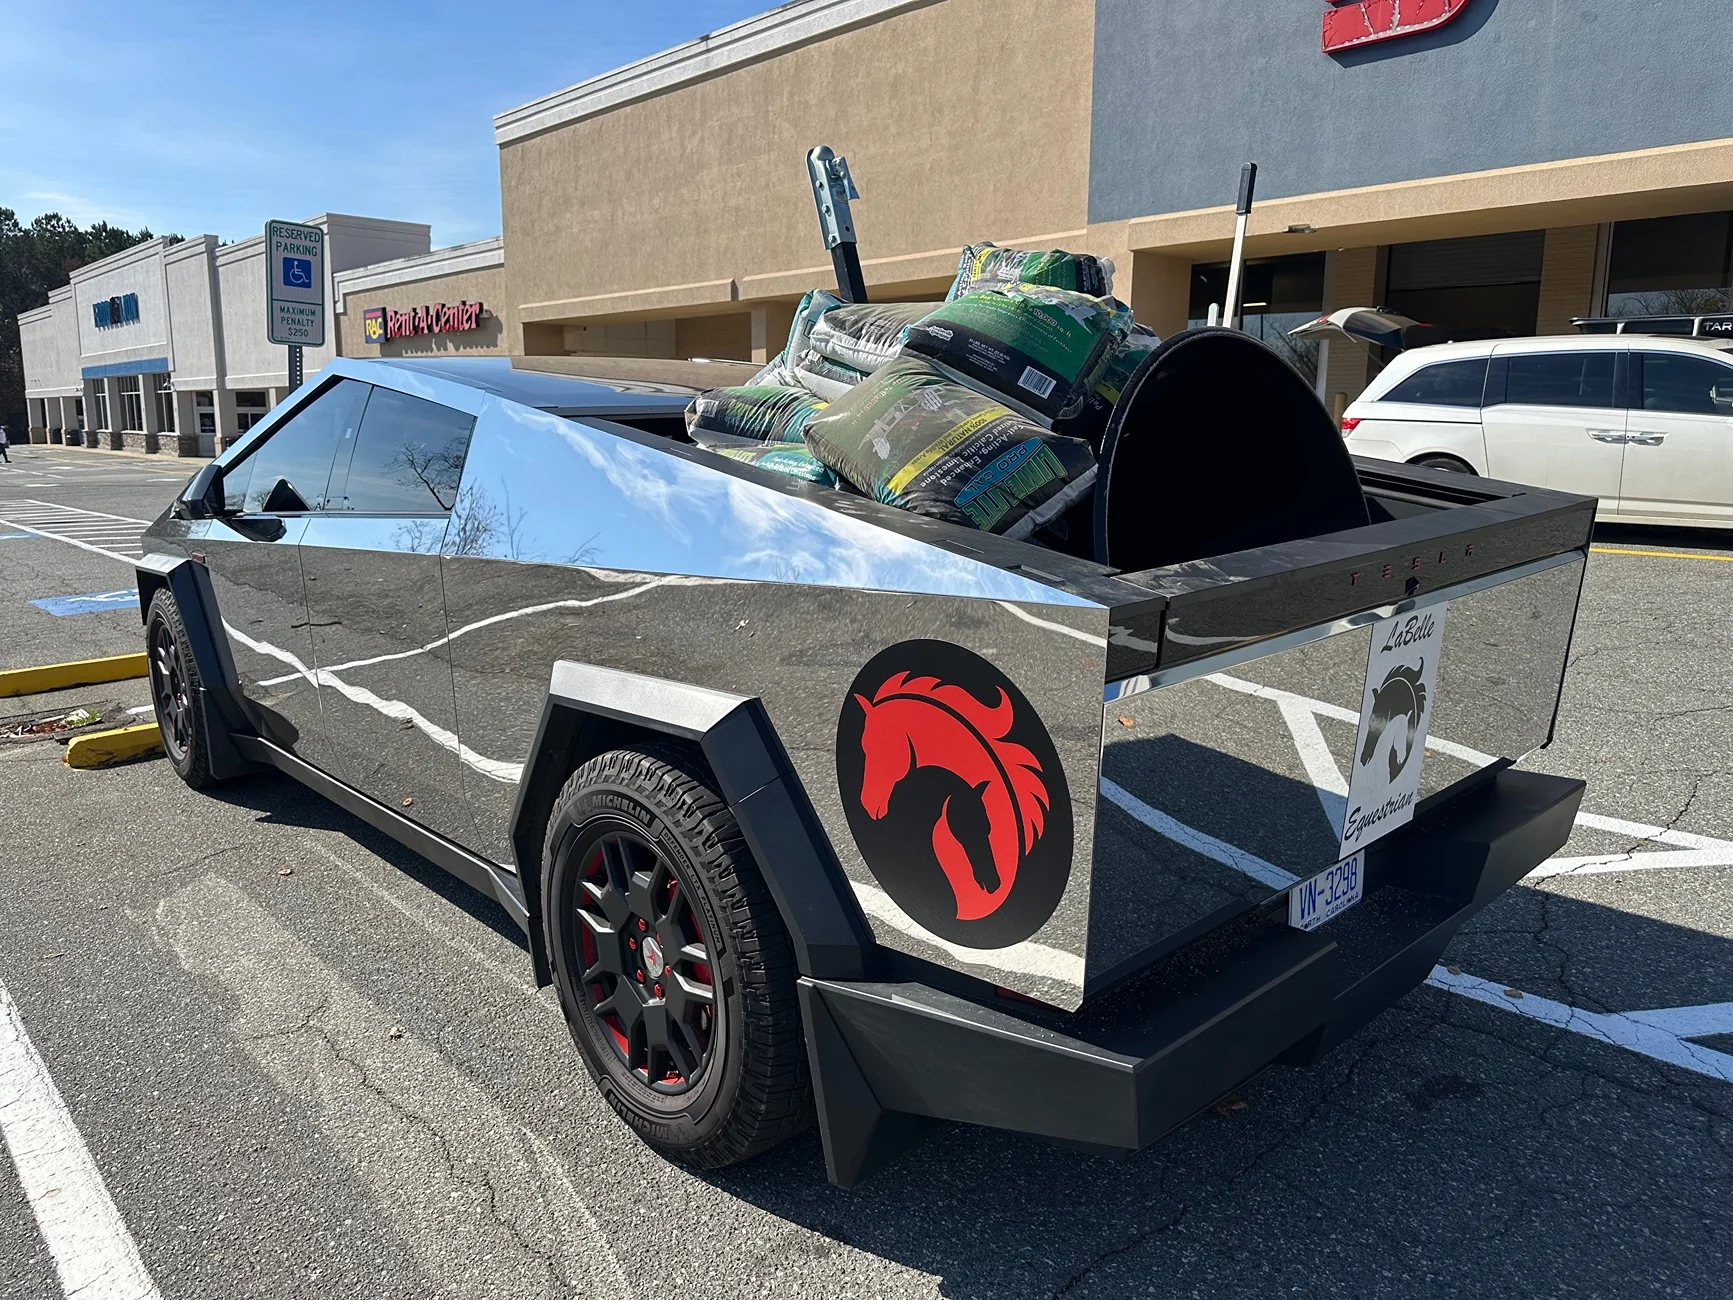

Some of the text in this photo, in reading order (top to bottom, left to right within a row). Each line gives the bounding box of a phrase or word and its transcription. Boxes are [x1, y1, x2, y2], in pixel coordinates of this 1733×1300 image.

[272, 226, 321, 243] RESERVED
[276, 241, 318, 257] PARKING
[279, 306, 316, 317] MAXIMUM
[280, 316, 315, 327] PENALTY
[287, 327, 309, 338] $250
[365, 317, 384, 340] RAC
[970, 417, 988, 429] 100%
[938, 427, 972, 453] NATURAL
[962, 431, 994, 457] Calcitic
[911, 453, 927, 466] Areas
[920, 456, 963, 488] Limestone
[940, 455, 982, 486] Enhanced
[965, 445, 1029, 493] PRO CAL
[1350, 543, 1475, 587] TESLA
[1380, 612, 1435, 654] LaBelle
[592, 794, 651, 826] MICHELIN
[1344, 791, 1414, 843] Equestrian
[663, 832, 722, 945] DEFENDER LTX PLATINUM
[1299, 856, 1358, 921] VN-3298
[609, 1091, 670, 1140] MICHELIN
